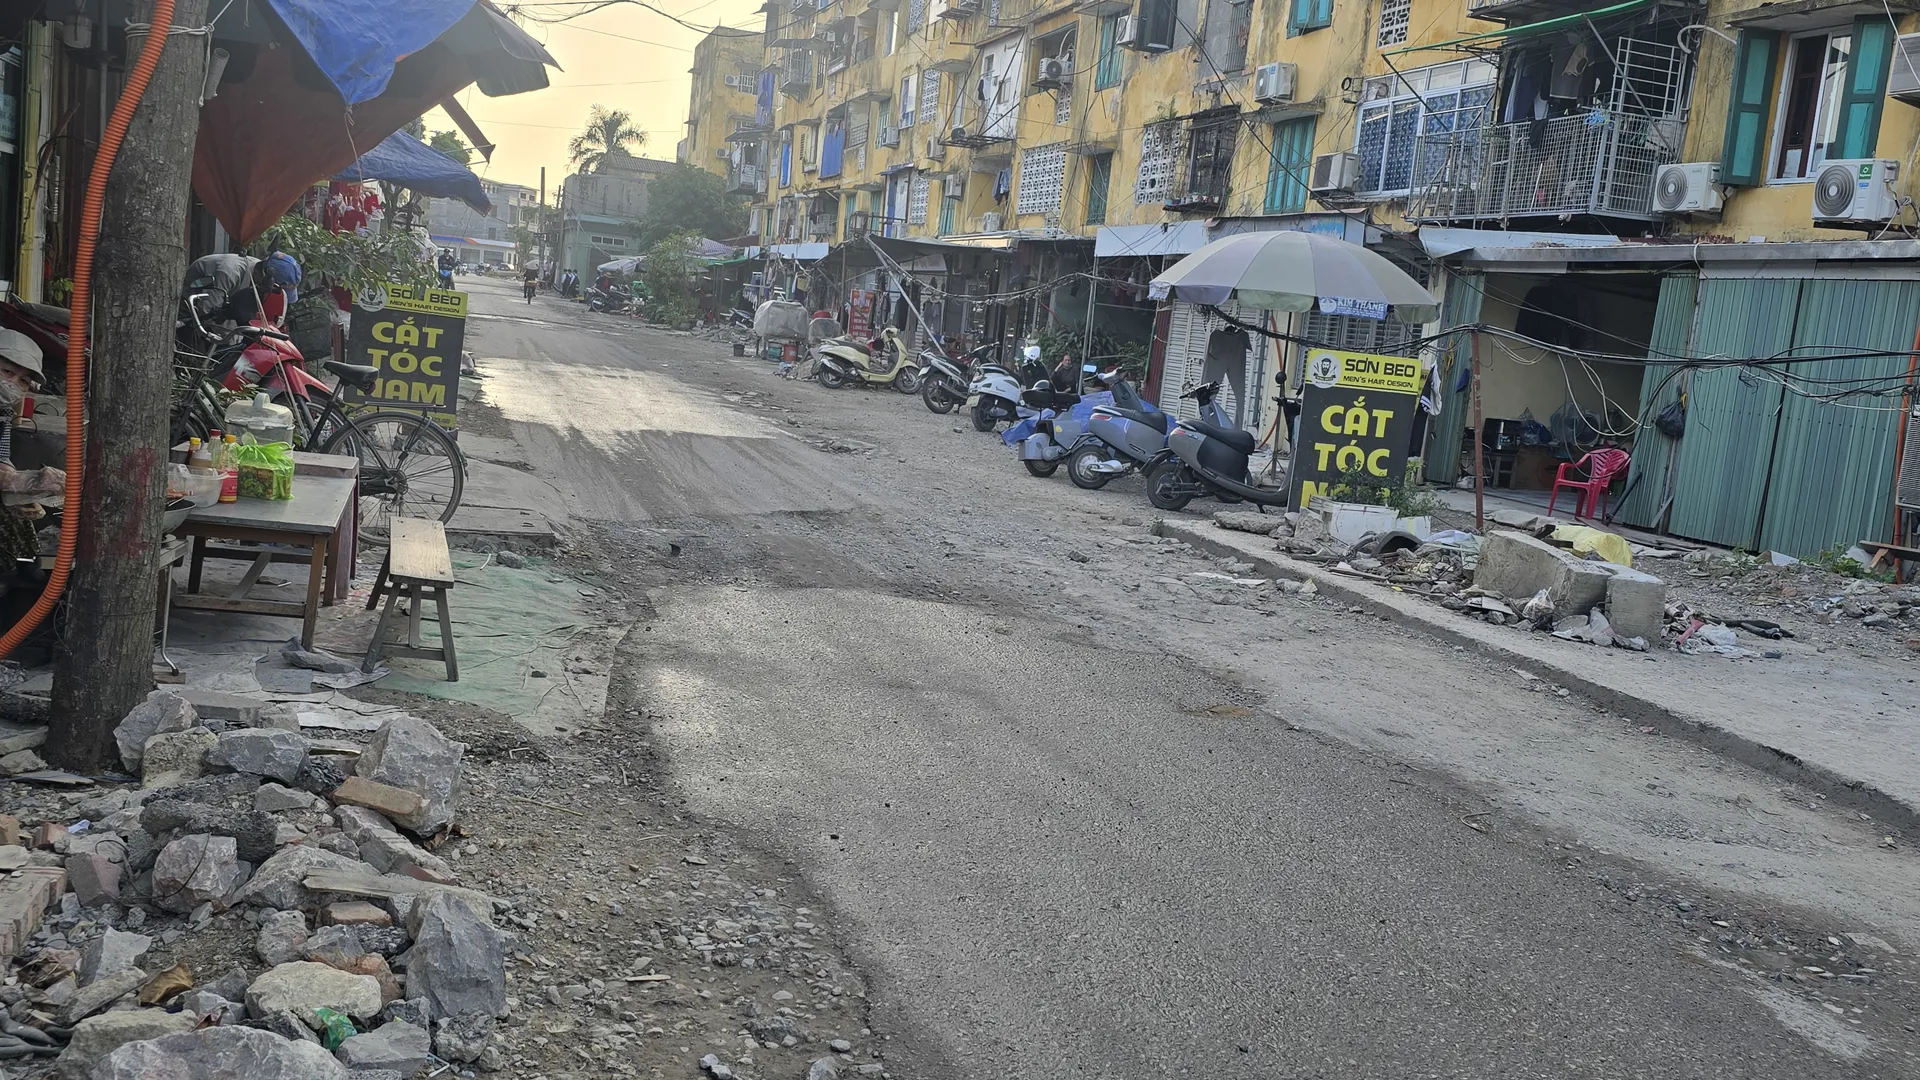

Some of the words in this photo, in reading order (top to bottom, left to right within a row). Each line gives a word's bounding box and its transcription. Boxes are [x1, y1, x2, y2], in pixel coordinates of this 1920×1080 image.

[391, 287, 425, 302] SƠ
[429, 292, 461, 306] BEO
[1337, 297, 1353, 308] KIM
[414, 302, 432, 310] HAIR
[434, 306, 460, 314] DESIGN
[371, 316, 444, 349] CẮT
[367, 348, 443, 377] TÓC
[1344, 357, 1380, 376] SƠN
[1383, 362, 1416, 378] BEO
[1343, 375, 1366, 384] MEN'S
[1368, 378, 1386, 386] HAIR
[1387, 380, 1413, 388] DESIGN
[1320, 396, 1394, 438] CẮT
[1314, 440, 1390, 477] TÓC
